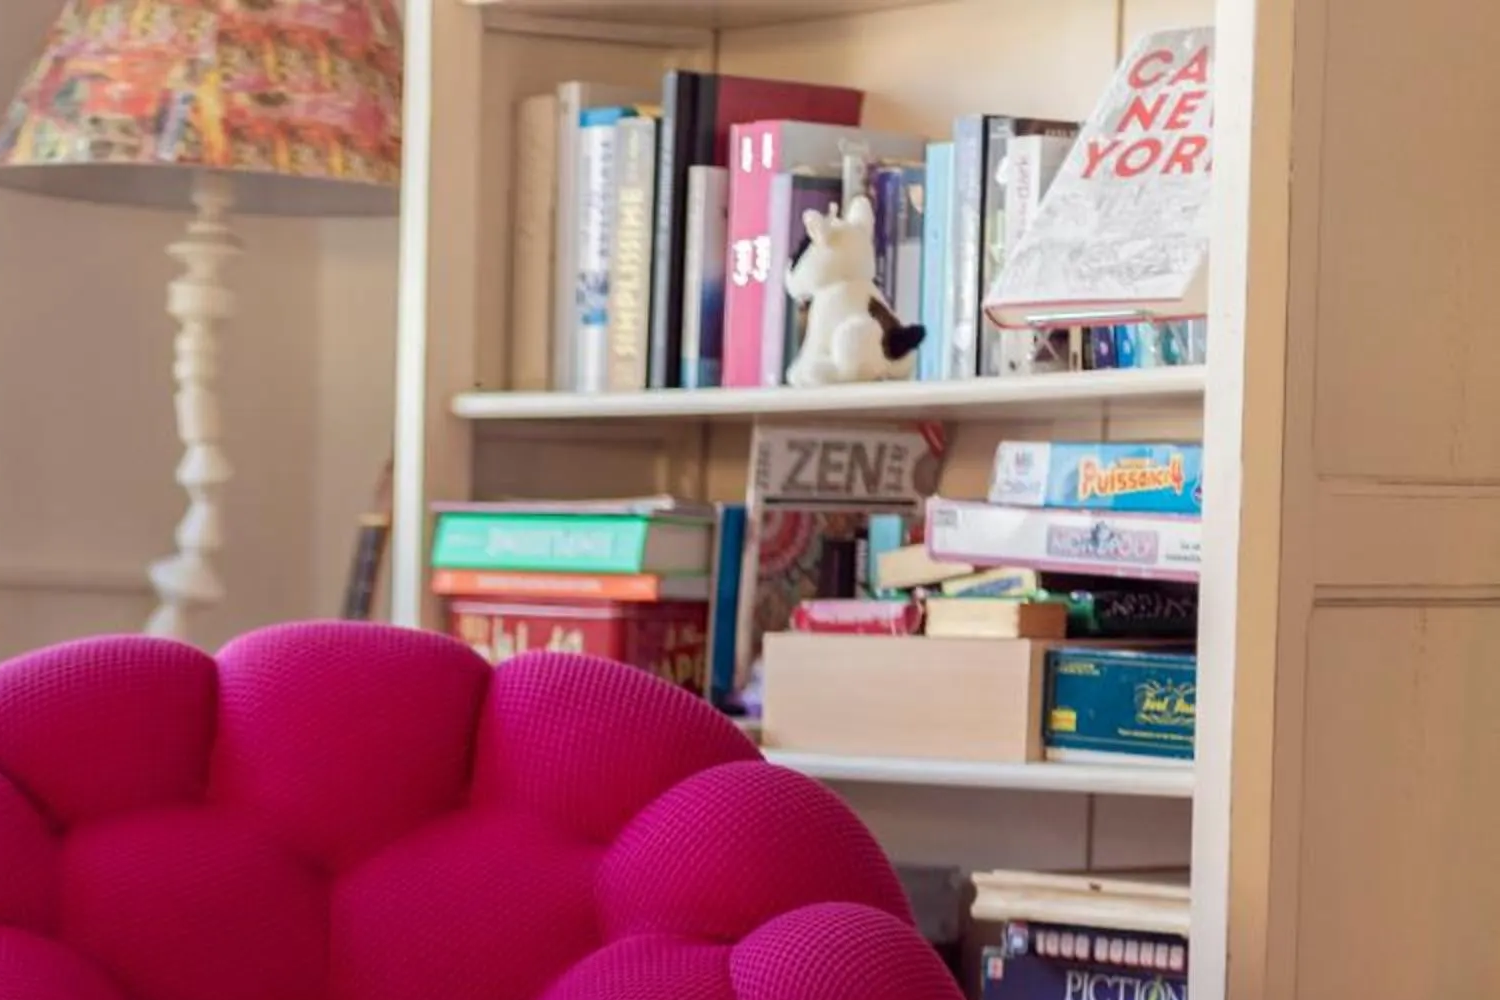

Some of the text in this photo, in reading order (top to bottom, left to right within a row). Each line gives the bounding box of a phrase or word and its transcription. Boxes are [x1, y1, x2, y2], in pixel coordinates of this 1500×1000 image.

[1116, 91, 1214, 133] NE
[1080, 133, 1213, 179] YOR
[780, 438, 888, 494] ZEN
